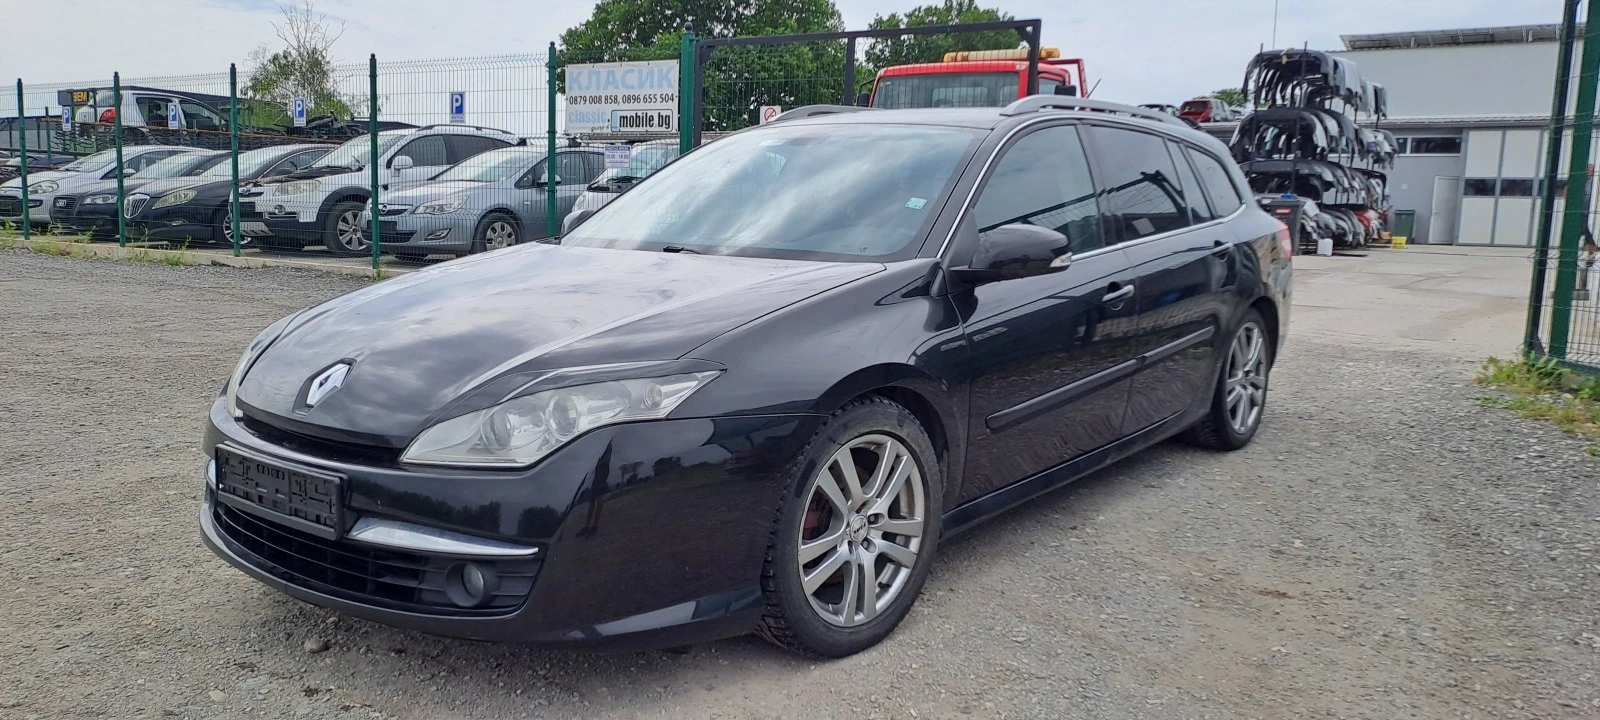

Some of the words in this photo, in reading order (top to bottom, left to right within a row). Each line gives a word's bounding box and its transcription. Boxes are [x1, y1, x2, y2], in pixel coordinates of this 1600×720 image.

[569, 67, 675, 91] КЛАСИК
[452, 94, 462, 114] P
[569, 95, 587, 105] 0879
[588, 95, 603, 105] 008
[604, 94, 620, 106] 858,
[622, 94, 641, 104] 0896
[643, 93, 658, 104] 655
[659, 93, 675, 103] 504
[169, 105, 176, 121] P
[295, 100, 303, 118] P
